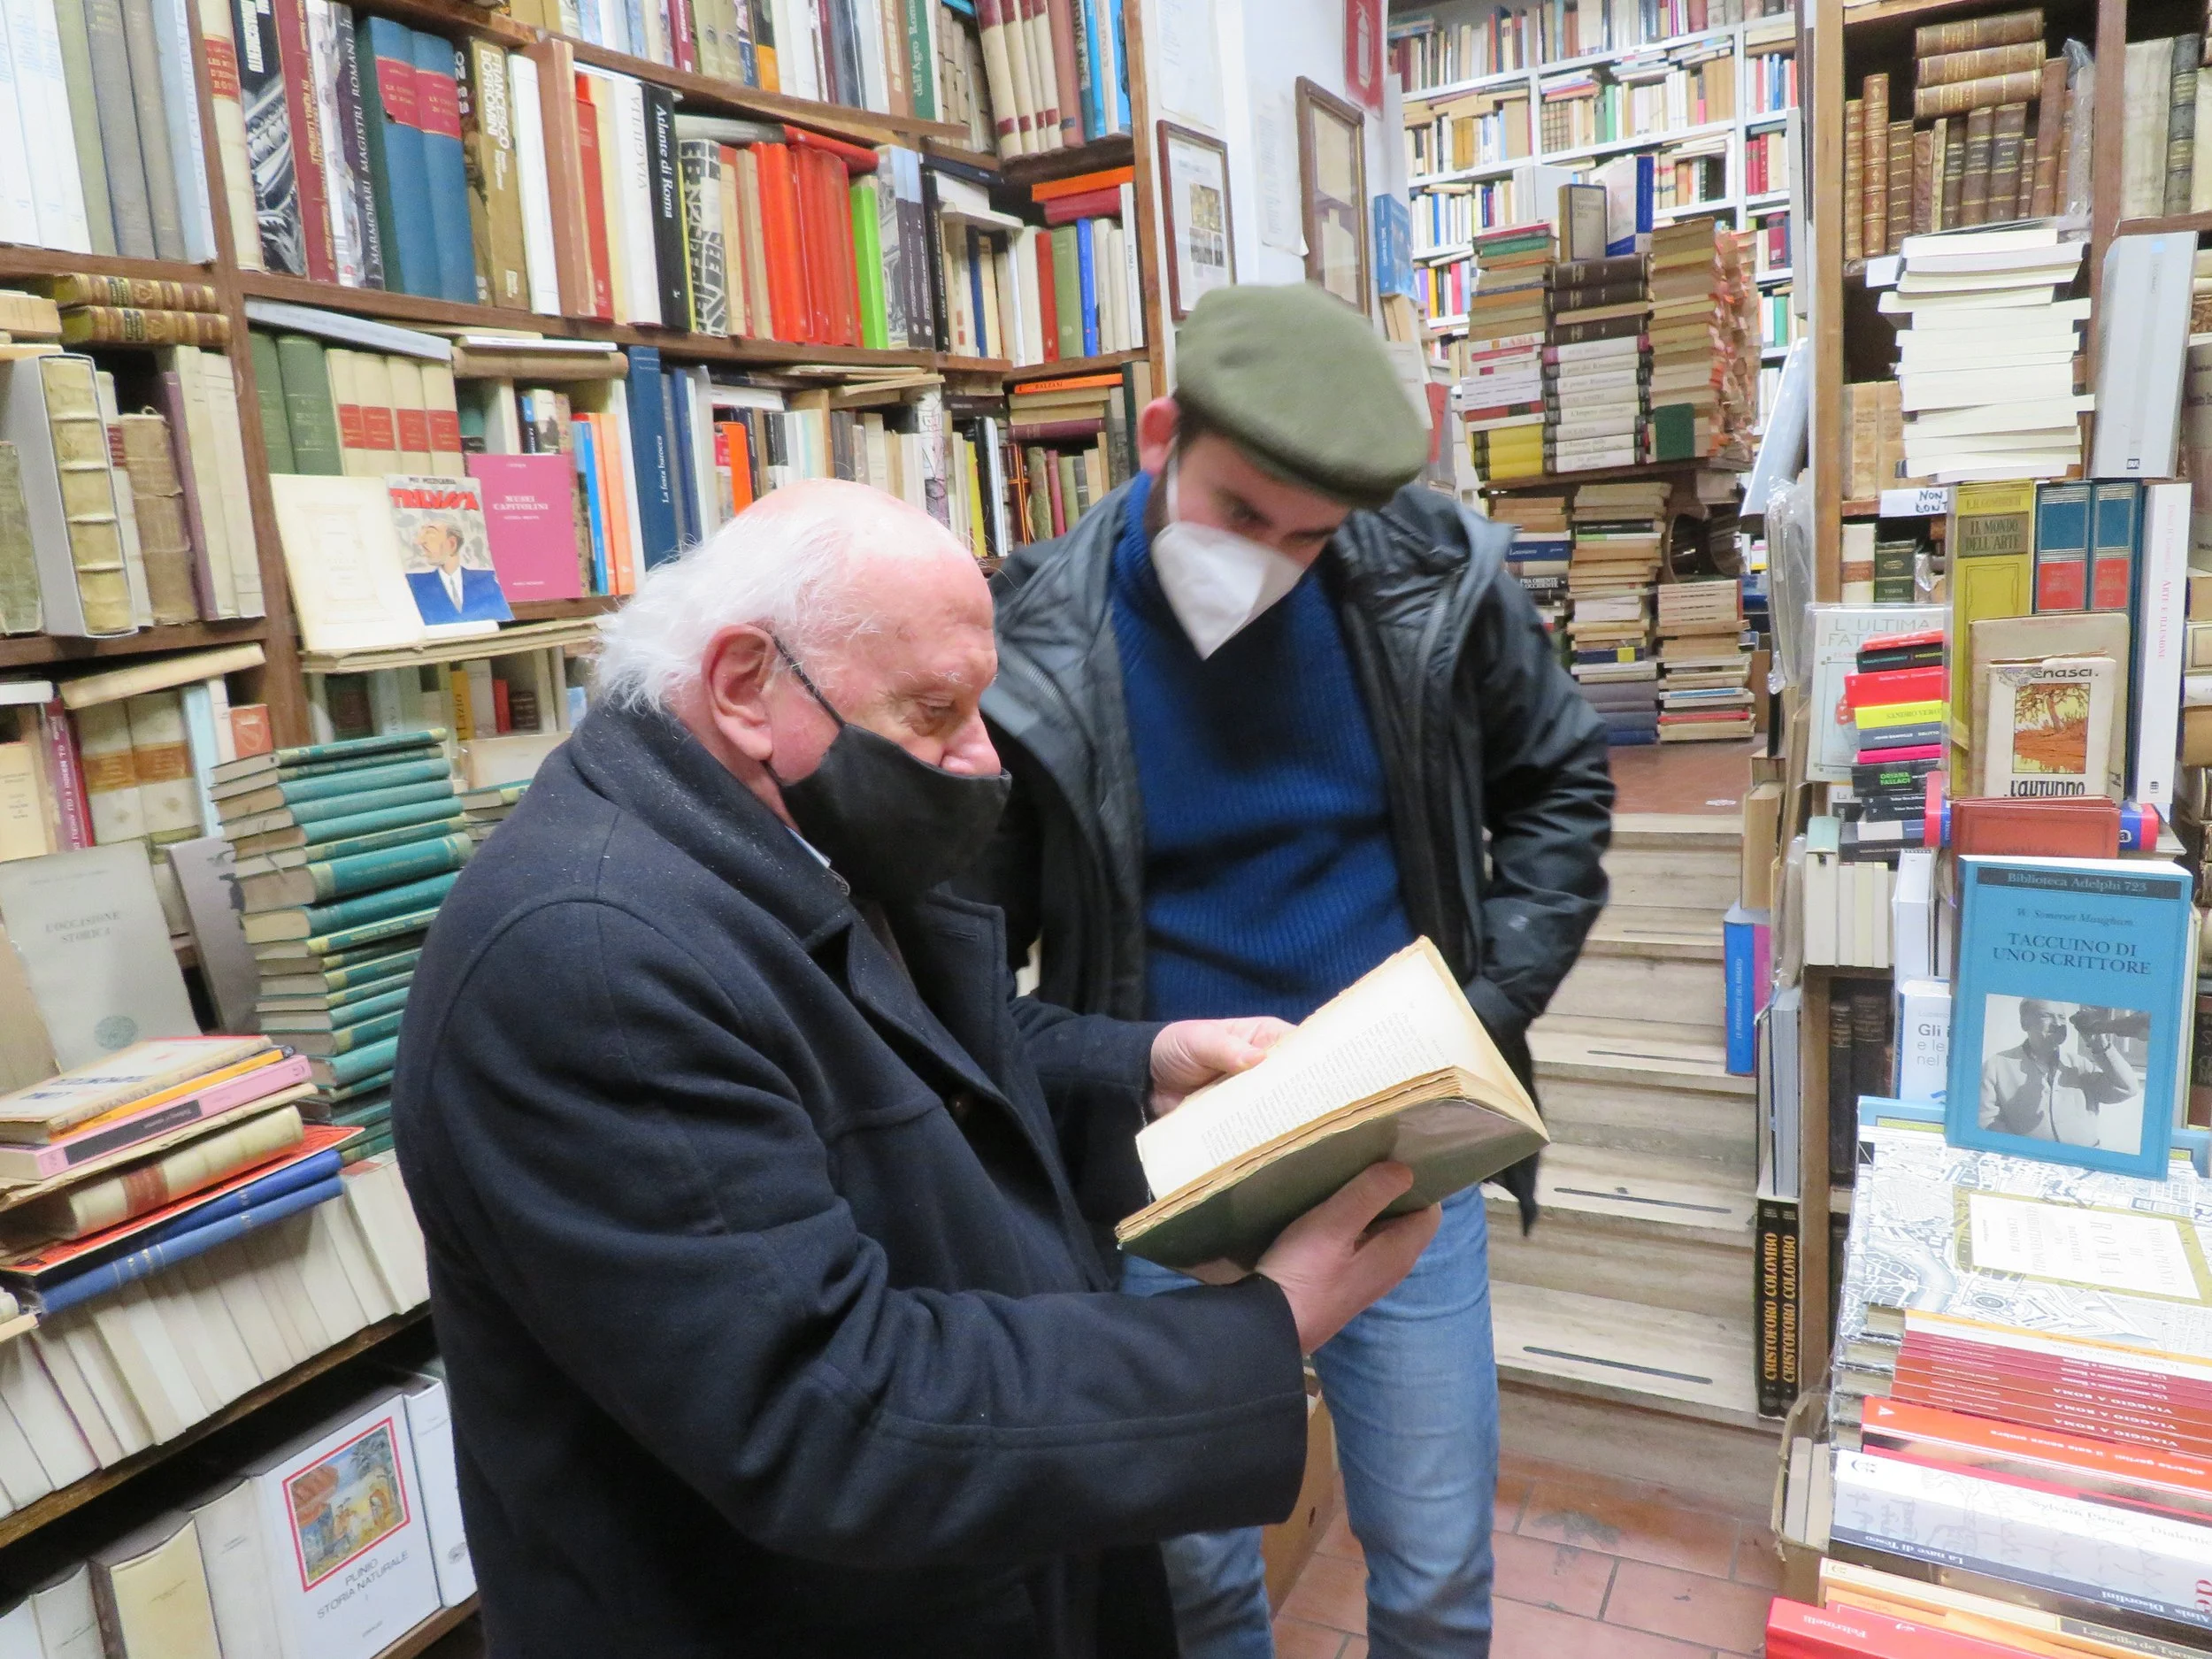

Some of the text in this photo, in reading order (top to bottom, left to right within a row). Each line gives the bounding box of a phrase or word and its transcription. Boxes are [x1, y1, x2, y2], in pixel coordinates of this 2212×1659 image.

[910, 41, 924, 96] dell'Agro
[480, 50, 498, 136] BORROMINI
[492, 52, 511, 150] FRANCESCO
[631, 96, 646, 157] GIULIA
[346, 38, 380, 265] MARMORARI MAGISTRI ROMANI
[655, 104, 672, 219] Atlante di Roma
[657, 435, 665, 470] barocca
[661, 492, 670, 503] La
[1919, 490, 1943, 501] NON
[1970, 518, 2019, 534] IL MONDO
[2008, 872, 2067, 887] Biblioteca
[2071, 878, 2121, 892] Adelphi
[2036, 908, 2075, 922] Somerset
[2080, 913, 2134, 927] Maugham
[2008, 933, 2139, 957] TACCUINO DI
[1993, 947, 2152, 975] UNO SCRITTORE
[1918, 1024, 1941, 1036] Gli
[1917, 1039, 1946, 1052] e le
[1917, 1055, 1939, 1066] nel
[2089, 1221, 2124, 1274] ROMA
[1764, 1232, 1778, 1381] CRISTOFORO COLOMBO
[1783, 1234, 1795, 1383] CRISTOFORO COLOMBO
[2062, 1358, 2089, 1367] Roma
[2100, 1363, 2150, 1376] americano
[2060, 1367, 2088, 1377] Roma
[2098, 1373, 2149, 1386] americano
[2061, 1377, 2089, 1386] Roma
[2098, 1383, 2150, 1396] americano
[2052, 1387, 2093, 1399] ROMA
[2054, 1402, 2095, 1414] ROMA
[2110, 1398, 2173, 1414] VIAGGIO
[2053, 1418, 2095, 1431] ROMA
[2113, 1414, 2177, 1430] VIAGGIO
[1990, 1430, 2027, 1440] ombra
[2031, 1438, 2064, 1448] senza
[2114, 1430, 2178, 1447] VIAGGIO
[2032, 1500, 2081, 1517] Sylvain
[1917, 1548, 1946, 1558] nave
[1948, 1555, 1963, 1564] La
[345, 1558, 379, 1586] PLINIO
[317, 1549, 409, 1619] STORIA NATURALE
[2101, 1591, 2165, 1613] Disordini
[1802, 1615, 1868, 1639] Feltrinelli
[2082, 1626, 2138, 1647] Lazarillo
[2139, 1640, 2156, 1650] de
